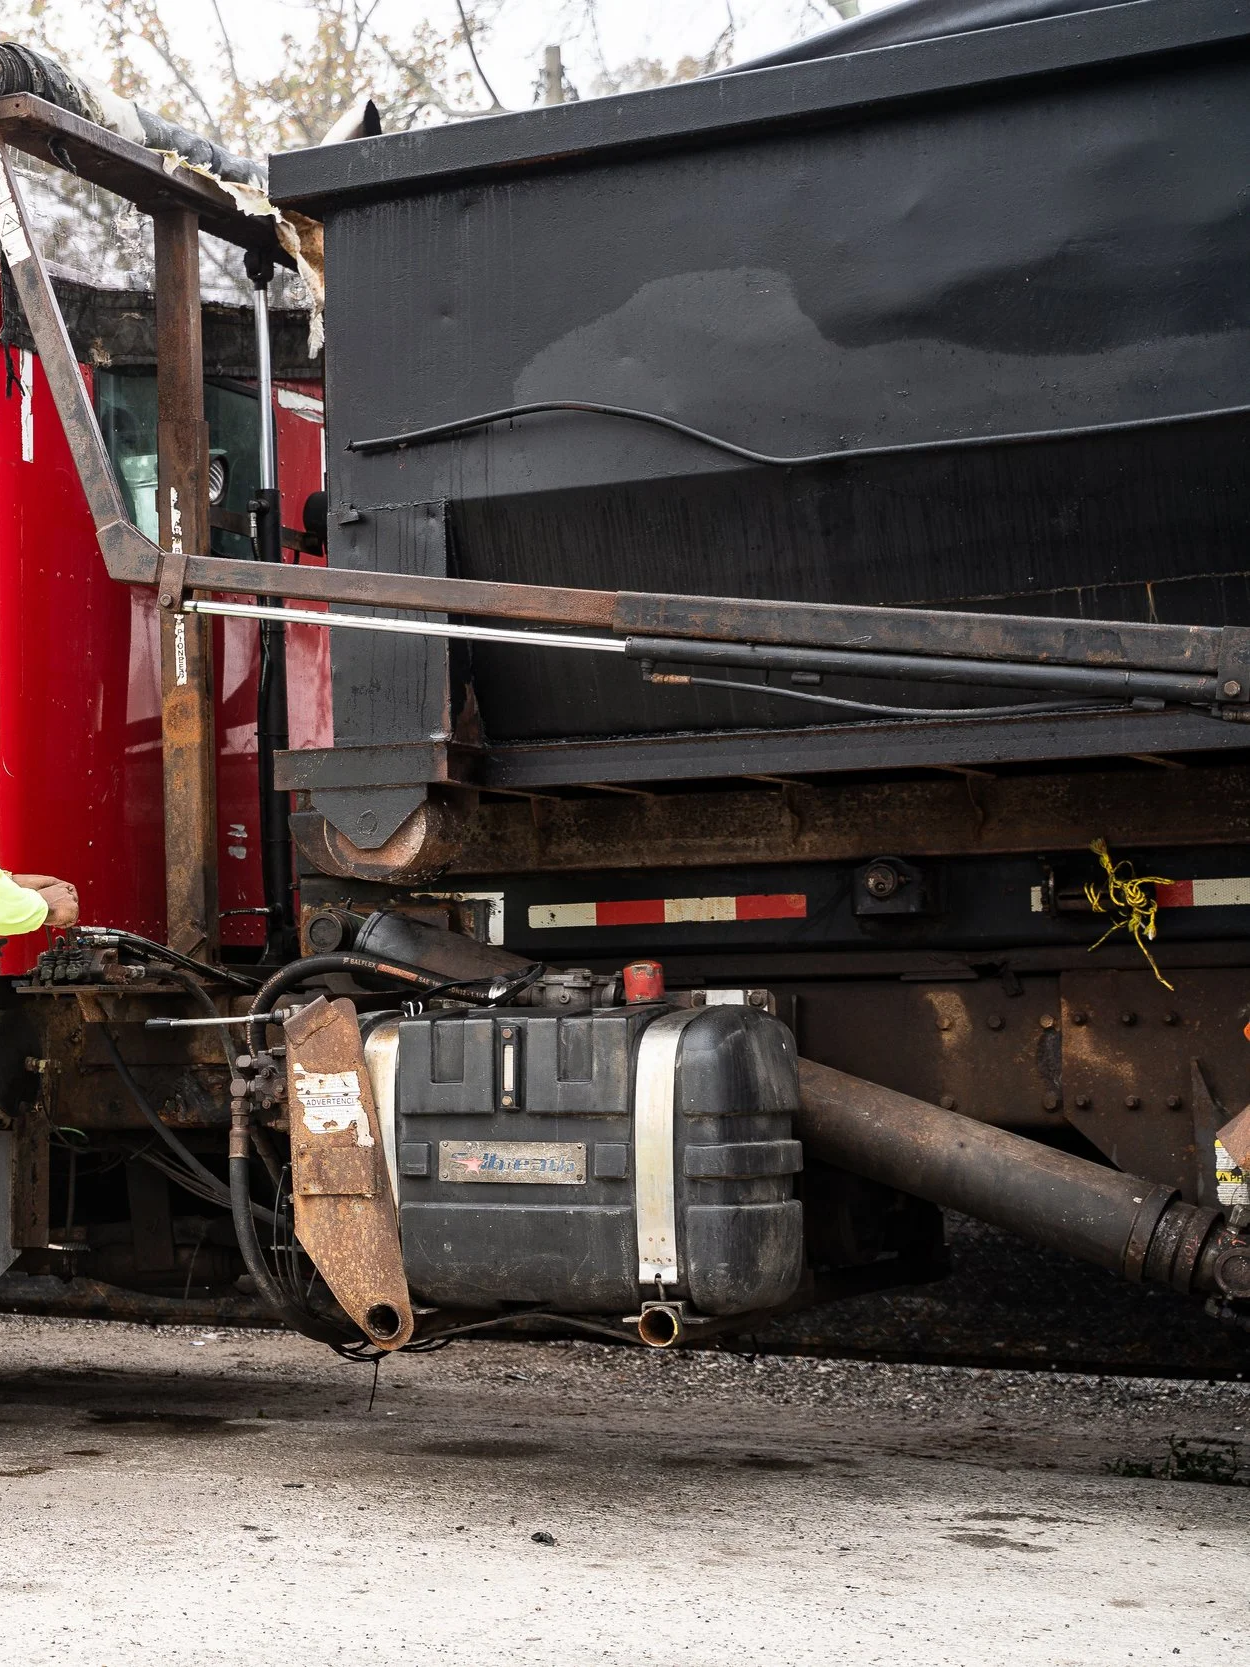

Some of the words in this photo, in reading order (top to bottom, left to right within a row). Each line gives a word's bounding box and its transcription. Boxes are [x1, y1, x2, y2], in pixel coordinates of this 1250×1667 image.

[350, 958, 377, 969] BALFLEX
[306, 1097, 358, 1106] ADVERTENCI
[450, 1152, 576, 1173] Glbreath
